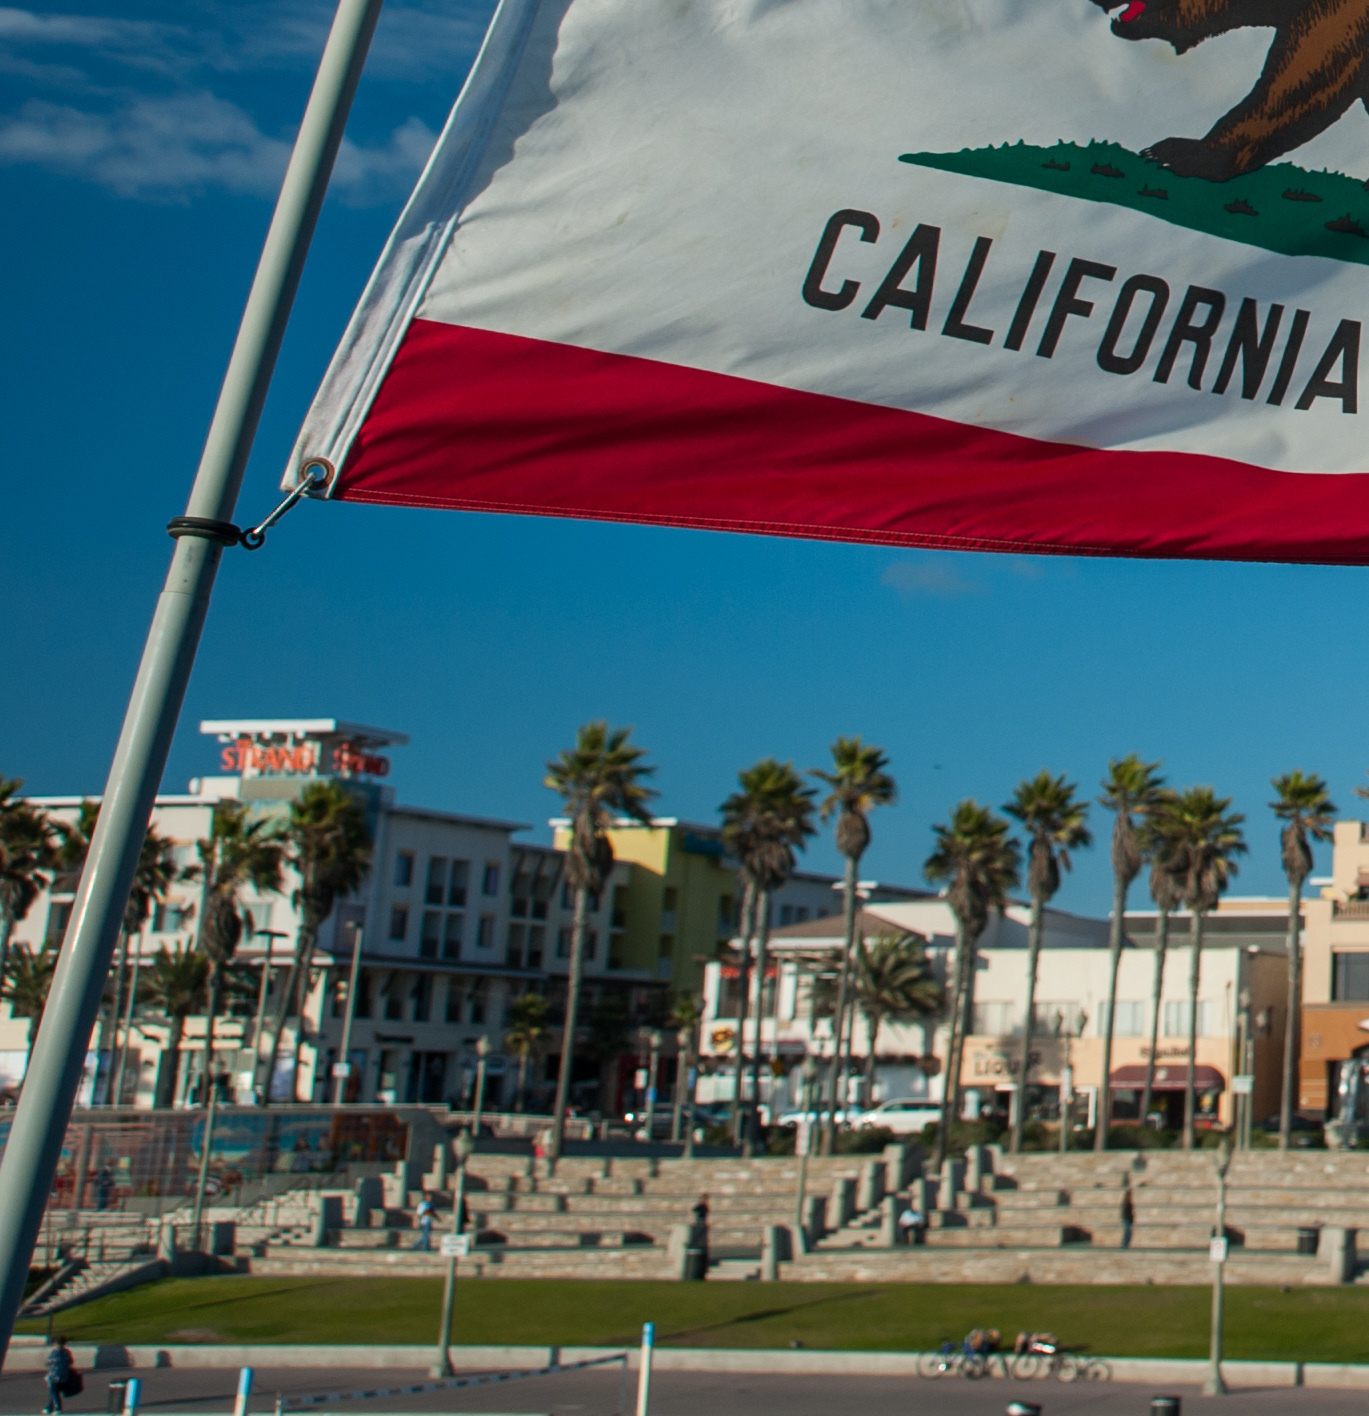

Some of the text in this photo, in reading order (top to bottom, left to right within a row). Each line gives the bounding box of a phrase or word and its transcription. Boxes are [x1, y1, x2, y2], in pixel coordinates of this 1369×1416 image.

[800, 208, 1363, 414] CALIFORNIA
[220, 739, 315, 771] STRAND
[974, 1051, 1043, 1076] LIQUR
